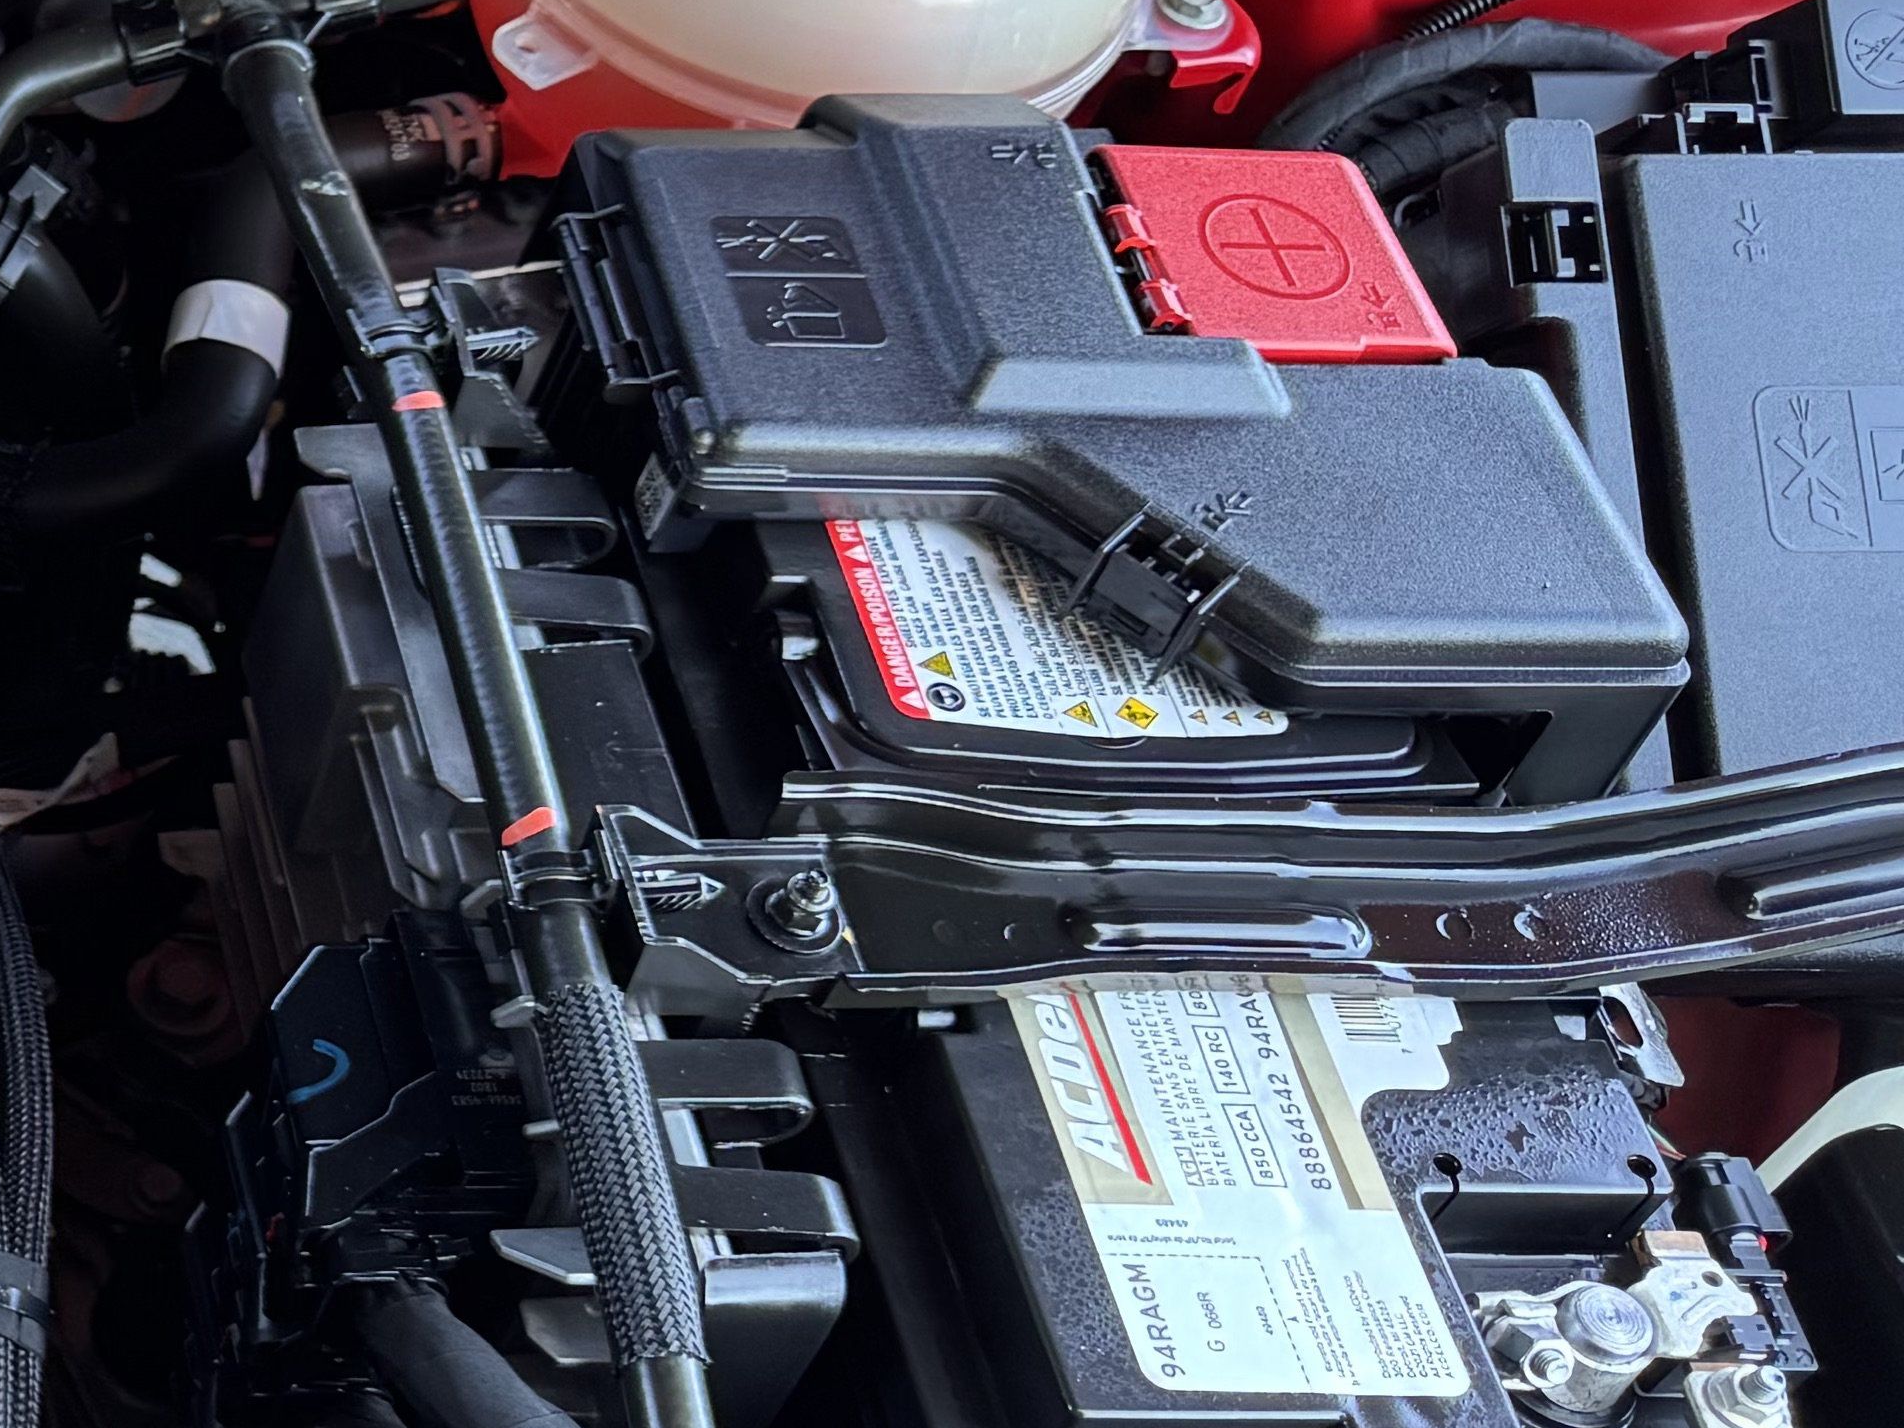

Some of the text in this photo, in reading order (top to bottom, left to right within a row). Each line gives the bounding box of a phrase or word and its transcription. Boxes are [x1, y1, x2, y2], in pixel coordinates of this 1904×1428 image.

[851, 568, 917, 688] DANGER/POISON
[1128, 1017, 1185, 1141] MAINTENANCE
[1171, 1072, 1191, 1110] SANS
[1175, 1054, 1192, 1072] DE
[1204, 1030, 1237, 1087] 140 RC
[1186, 1077, 1212, 1118] LIBRE
[1267, 1073, 1332, 1190] 88864542
[1182, 1117, 1220, 1186] BATTERIE
[1236, 1110, 1273, 1179] 850 CCA
[1122, 1263, 1186, 1378] 94RAGM
[1207, 1339, 1226, 1352] G
